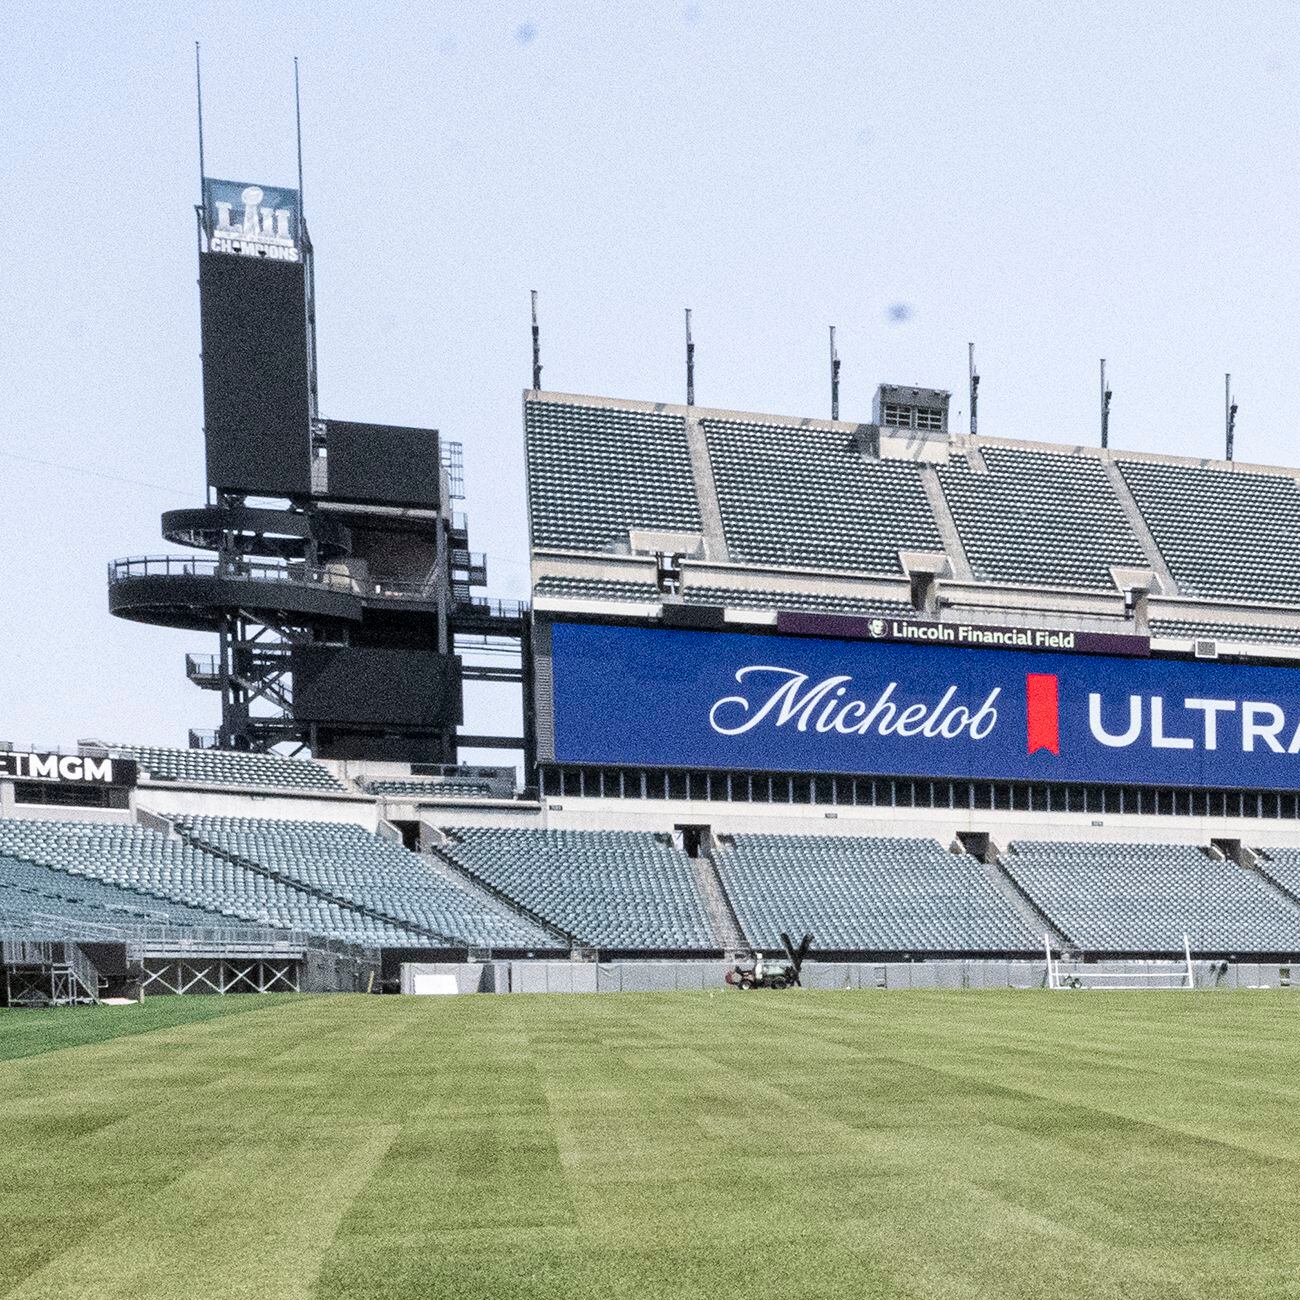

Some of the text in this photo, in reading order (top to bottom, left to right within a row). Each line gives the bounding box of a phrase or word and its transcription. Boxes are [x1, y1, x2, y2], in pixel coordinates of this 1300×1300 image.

[210, 237, 299, 262] CHAMPIONS
[892, 621, 1075, 649] Lincoln Financial Field
[709, 665, 1001, 740] Michelob
